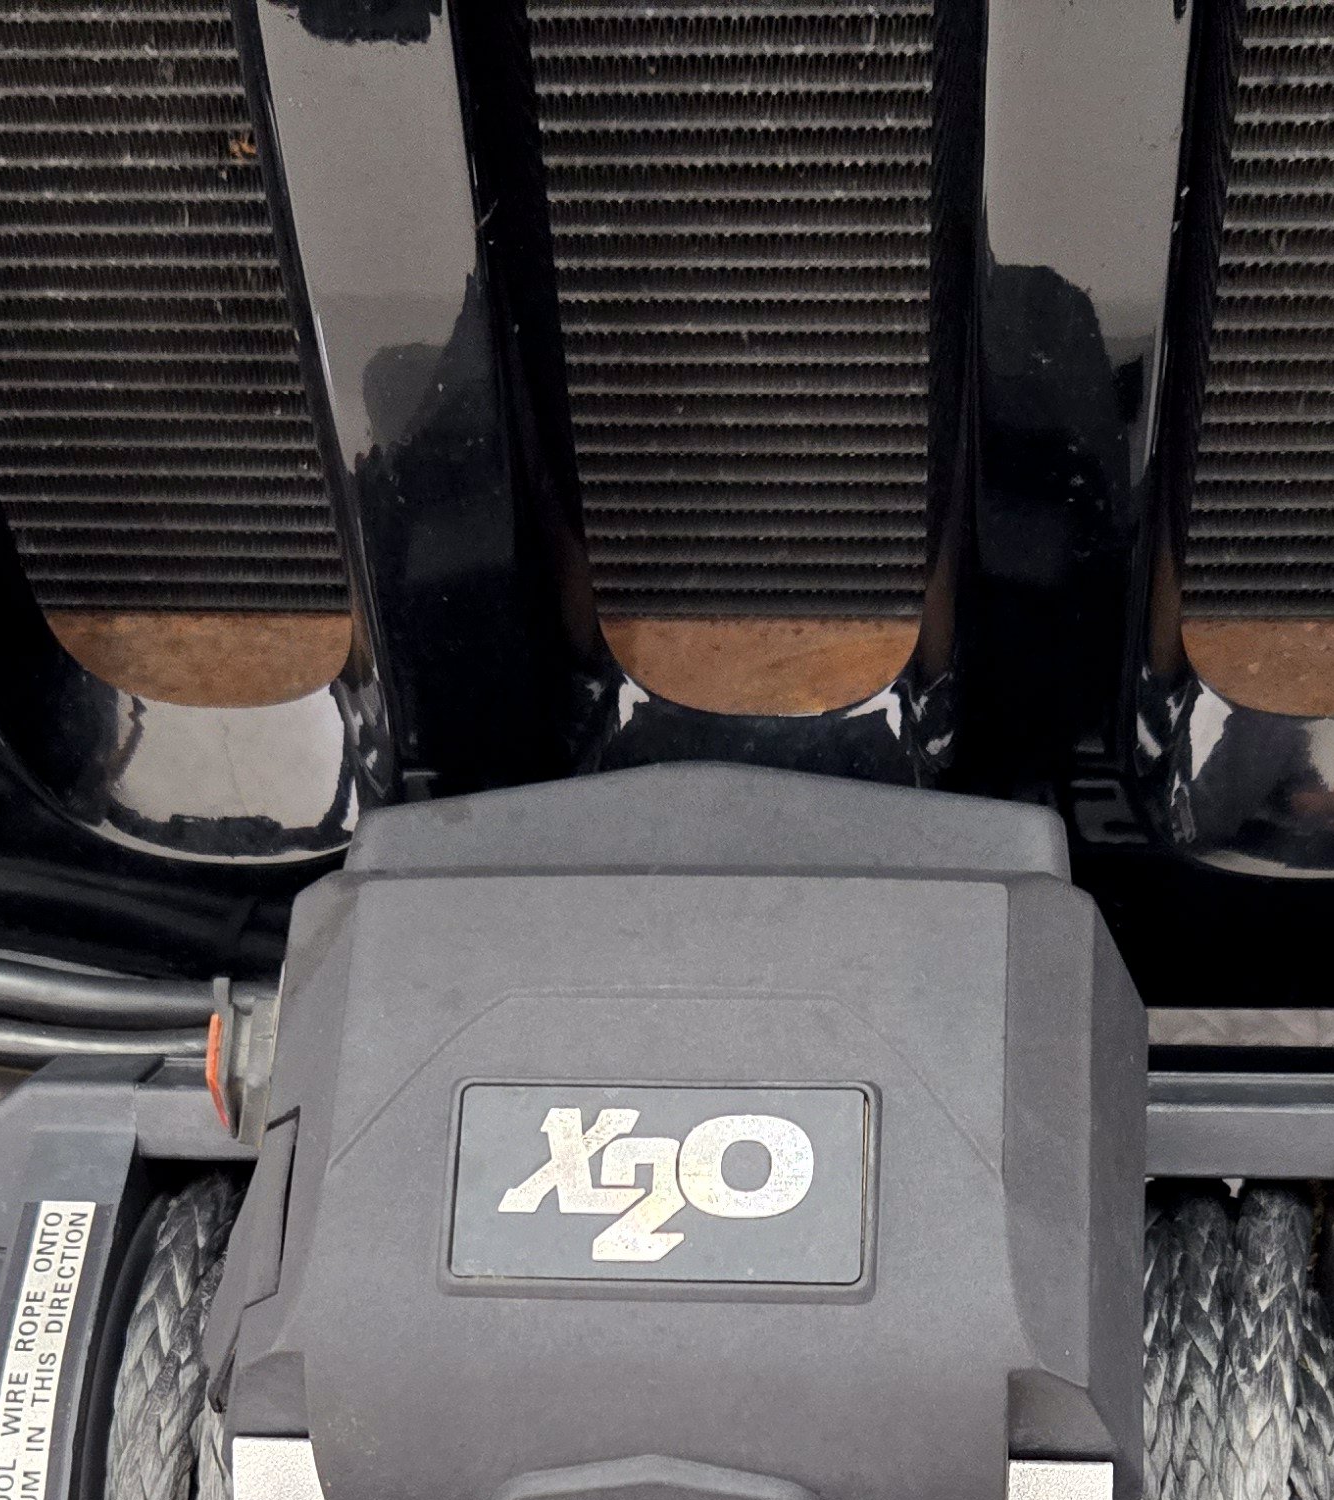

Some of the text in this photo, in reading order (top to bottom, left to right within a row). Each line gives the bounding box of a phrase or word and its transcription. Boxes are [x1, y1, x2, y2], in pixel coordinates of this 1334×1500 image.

[33, 1211, 63, 1273] ONTO
[44, 1212, 89, 1334] DIRECTION
[14, 1290, 47, 1352] ROPE
[0, 1372, 29, 1436] WIRE
[30, 1352, 57, 1408] THIS
[25, 1426, 46, 1452] IN
